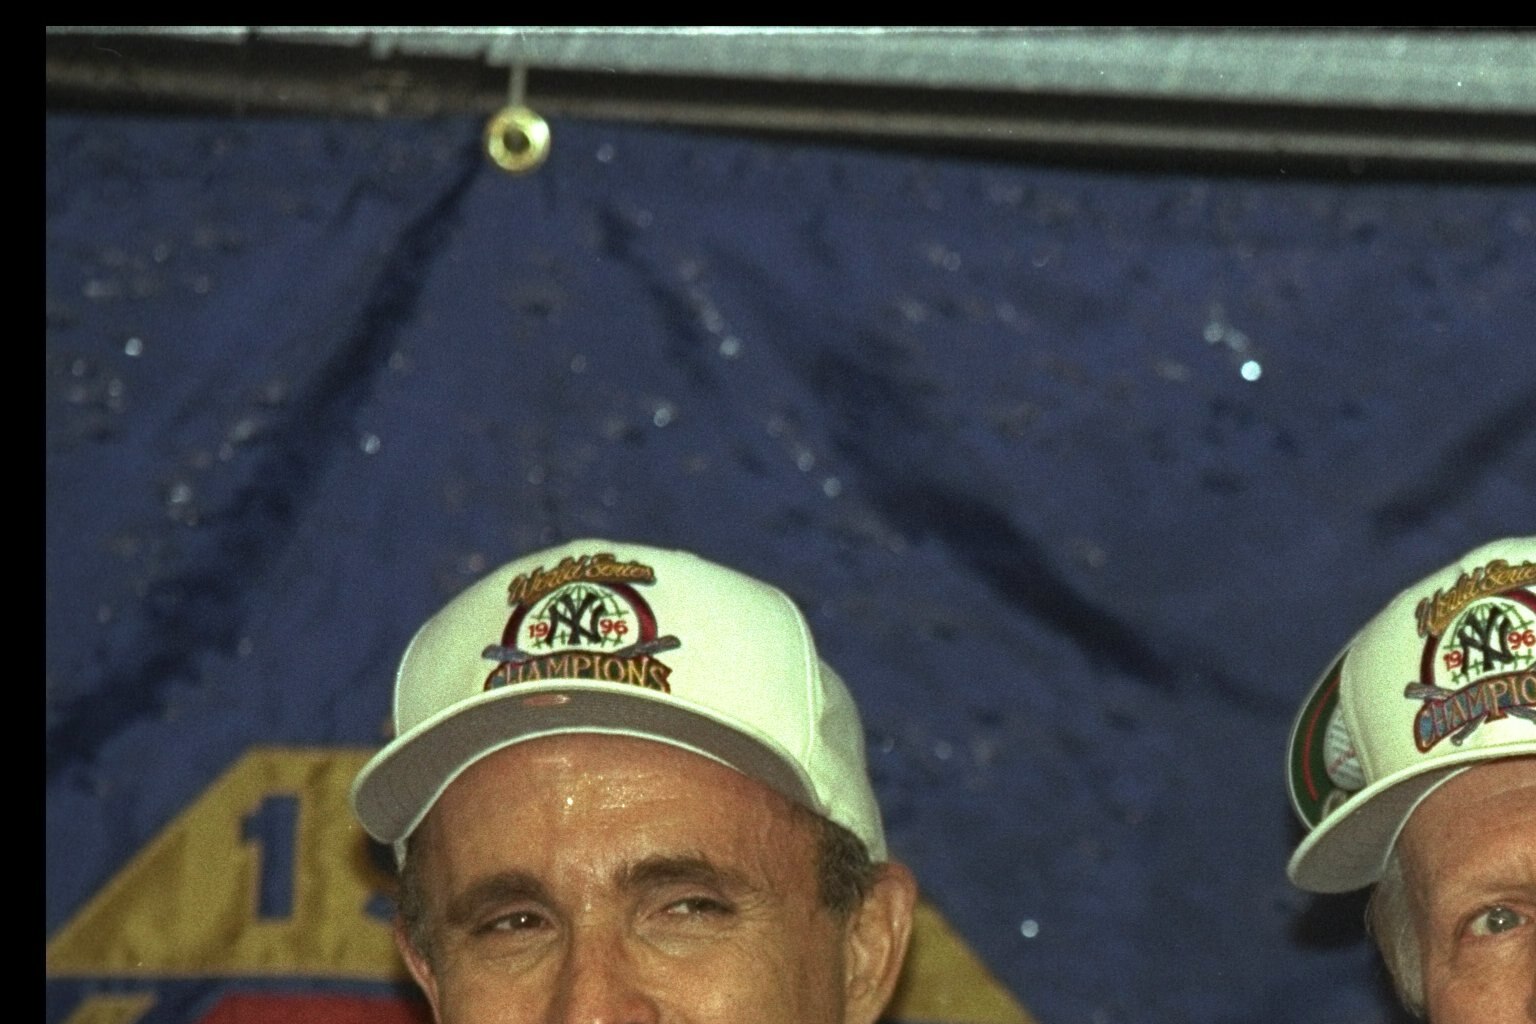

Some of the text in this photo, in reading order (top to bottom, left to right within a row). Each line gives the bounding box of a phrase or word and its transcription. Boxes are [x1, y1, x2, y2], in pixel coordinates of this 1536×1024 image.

[528, 592, 629, 647] 19 NY 96
[1443, 650, 1464, 672] 19
[1457, 605, 1516, 676] NY
